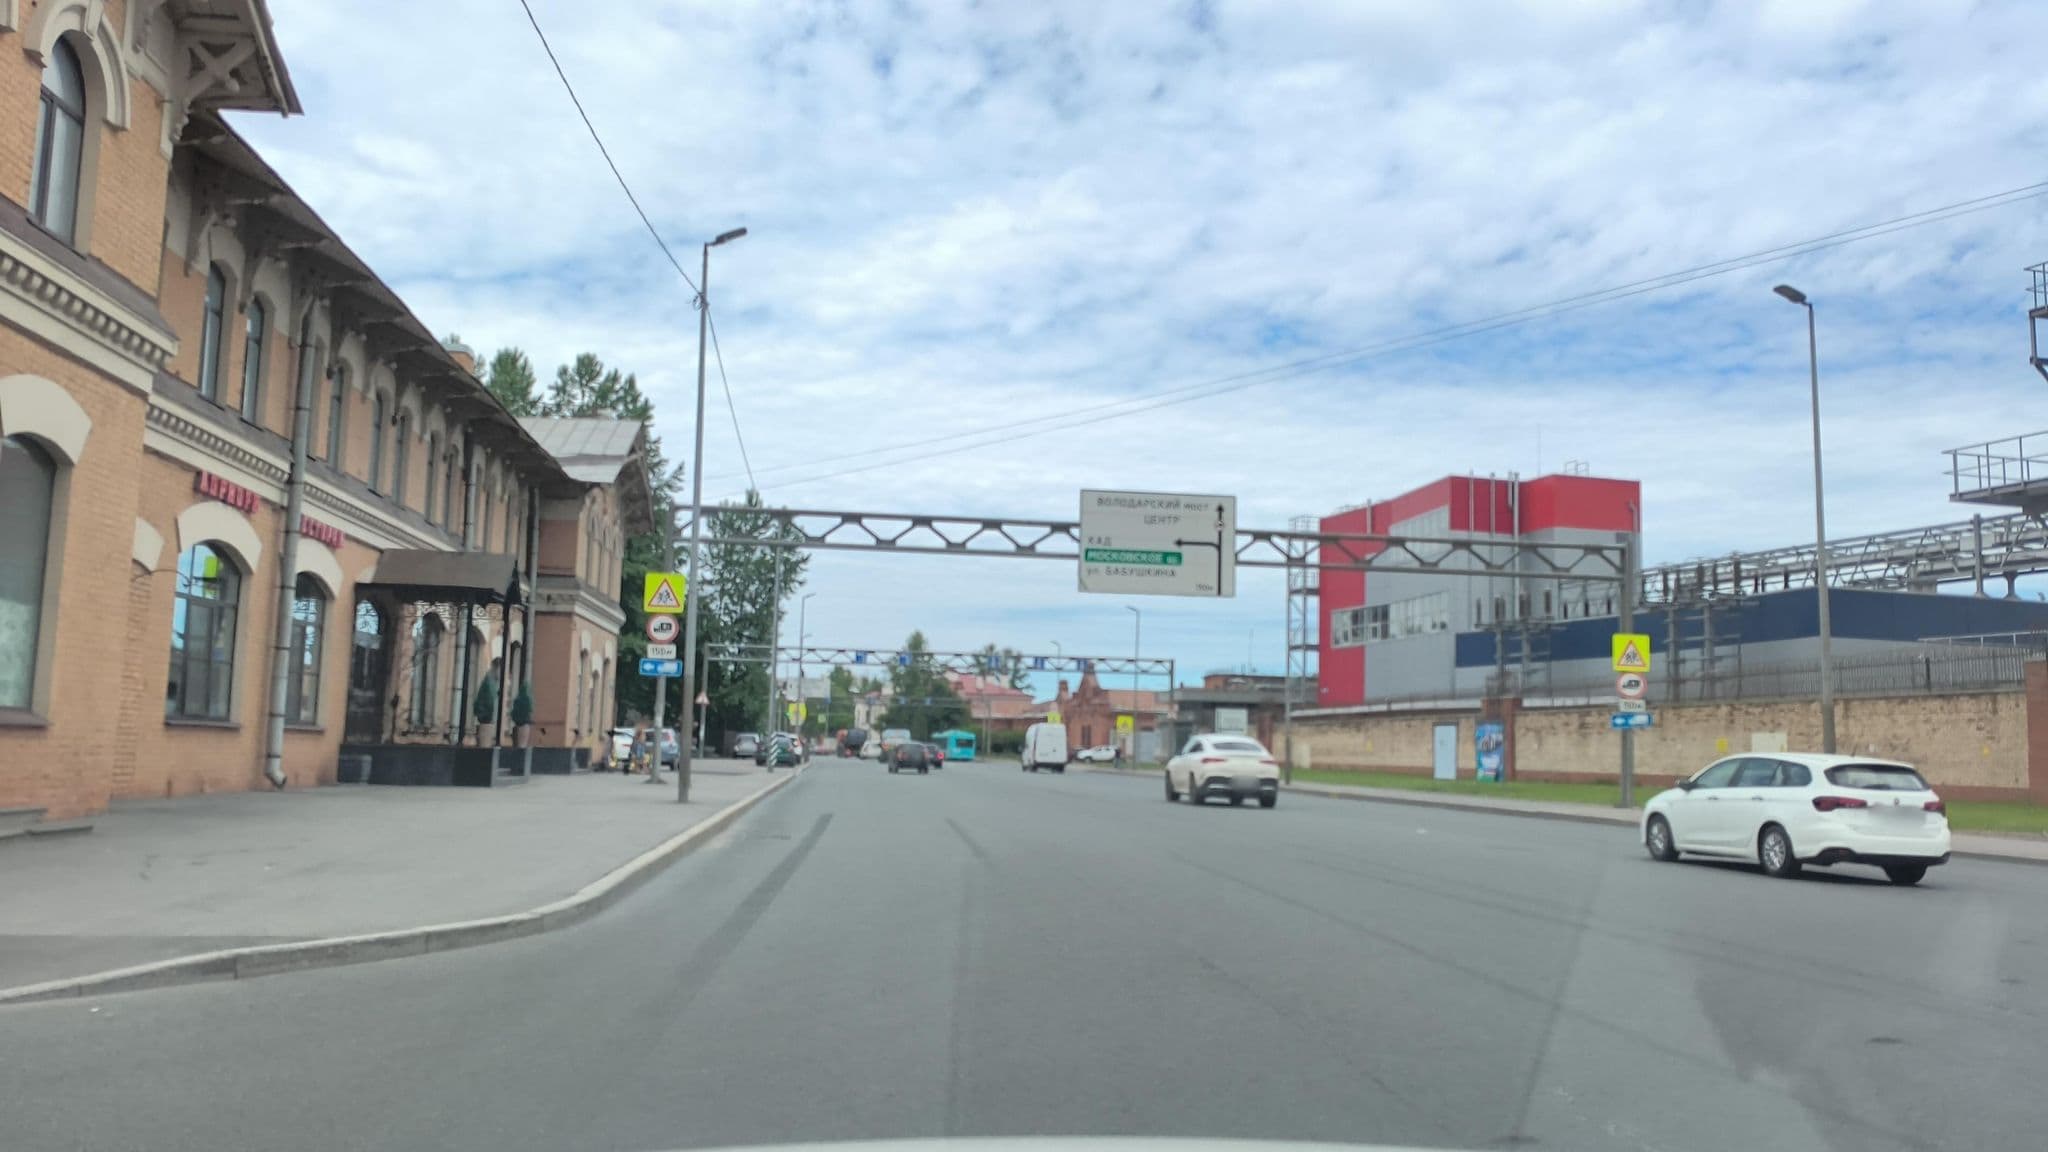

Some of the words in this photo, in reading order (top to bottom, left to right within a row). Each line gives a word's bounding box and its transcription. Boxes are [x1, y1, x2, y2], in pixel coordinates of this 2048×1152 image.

[1096, 497, 1180, 509] ВОЛОДАРСКИЙ
[1143, 514, 1181, 526] ЦЕНТР
[1087, 536, 1112, 546] КАД
[1087, 551, 1163, 564] МОСКОВСКОЕ
[1104, 567, 1177, 577] БАБУШКИНА
